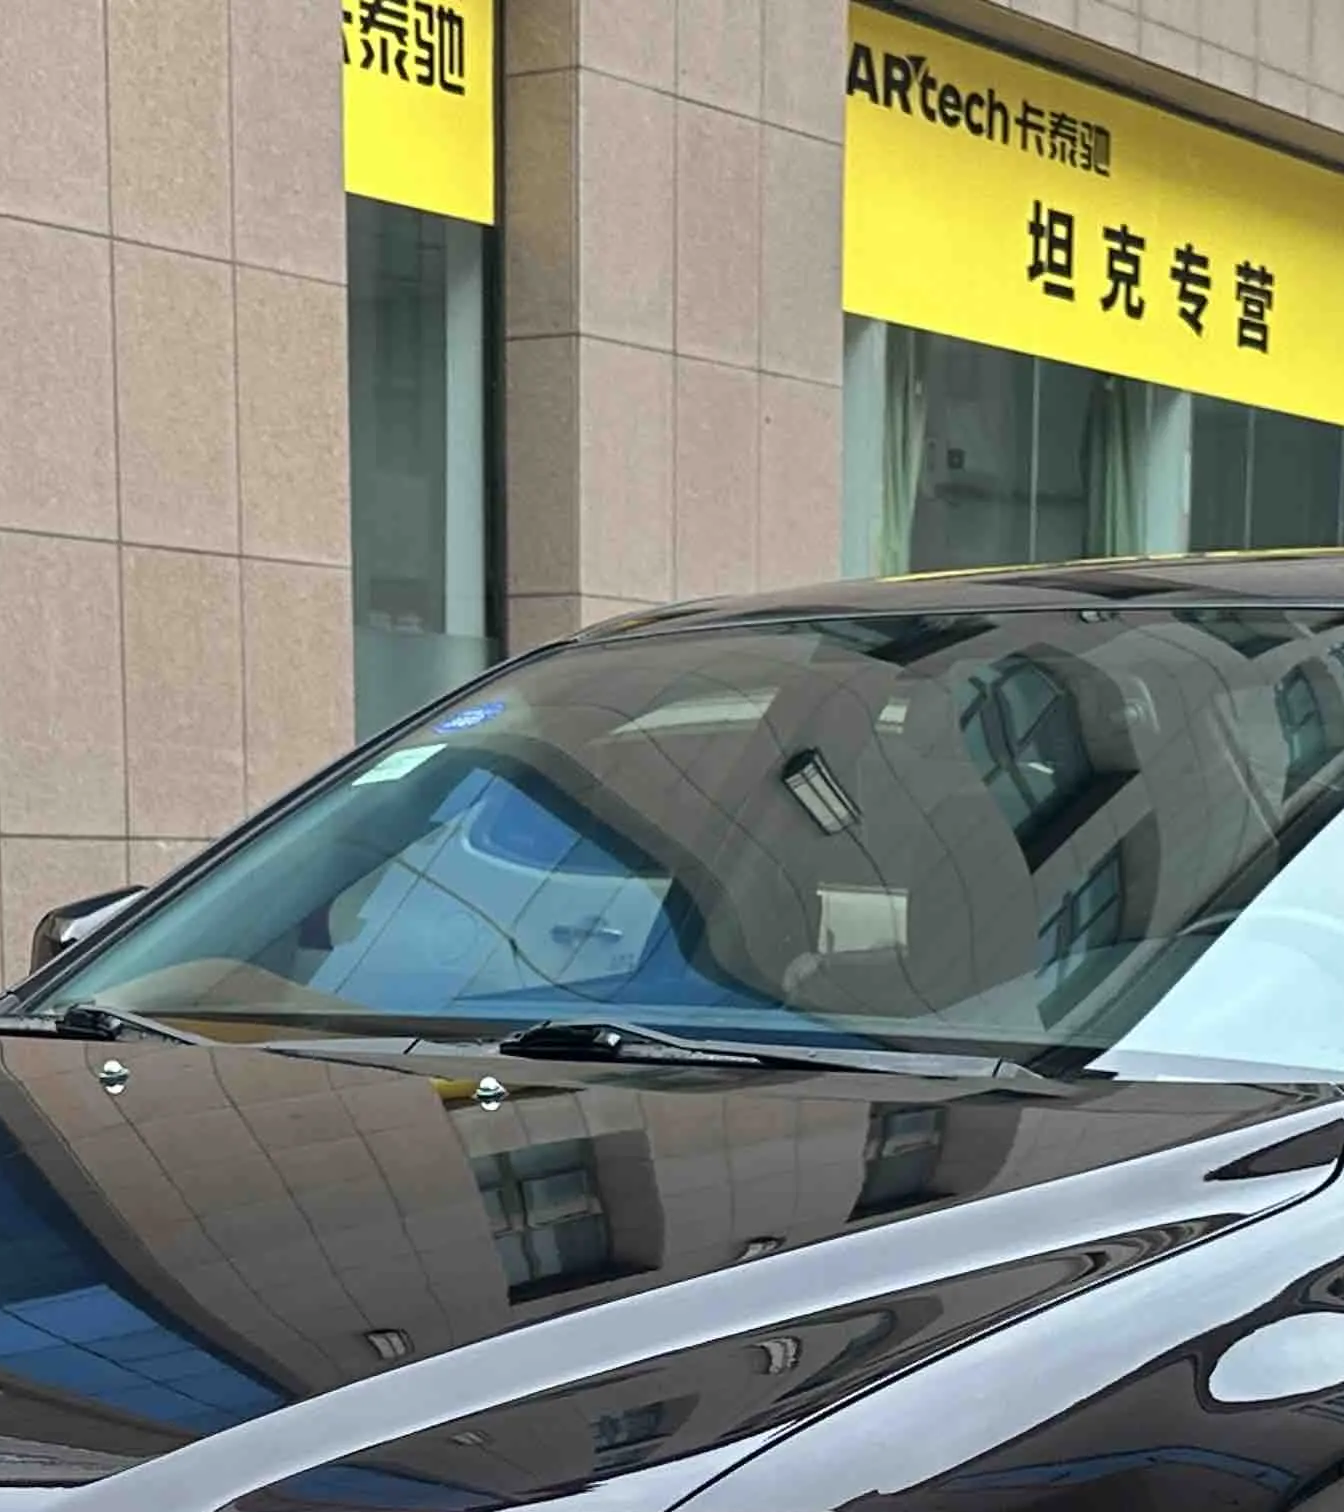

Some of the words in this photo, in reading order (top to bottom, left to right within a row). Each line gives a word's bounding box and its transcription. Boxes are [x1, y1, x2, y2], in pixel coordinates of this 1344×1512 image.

[342, 0, 466, 96] 泰驰
[1015, 100, 1112, 177] 卡泰驰
[1027, 199, 1275, 354] 坦克专营
